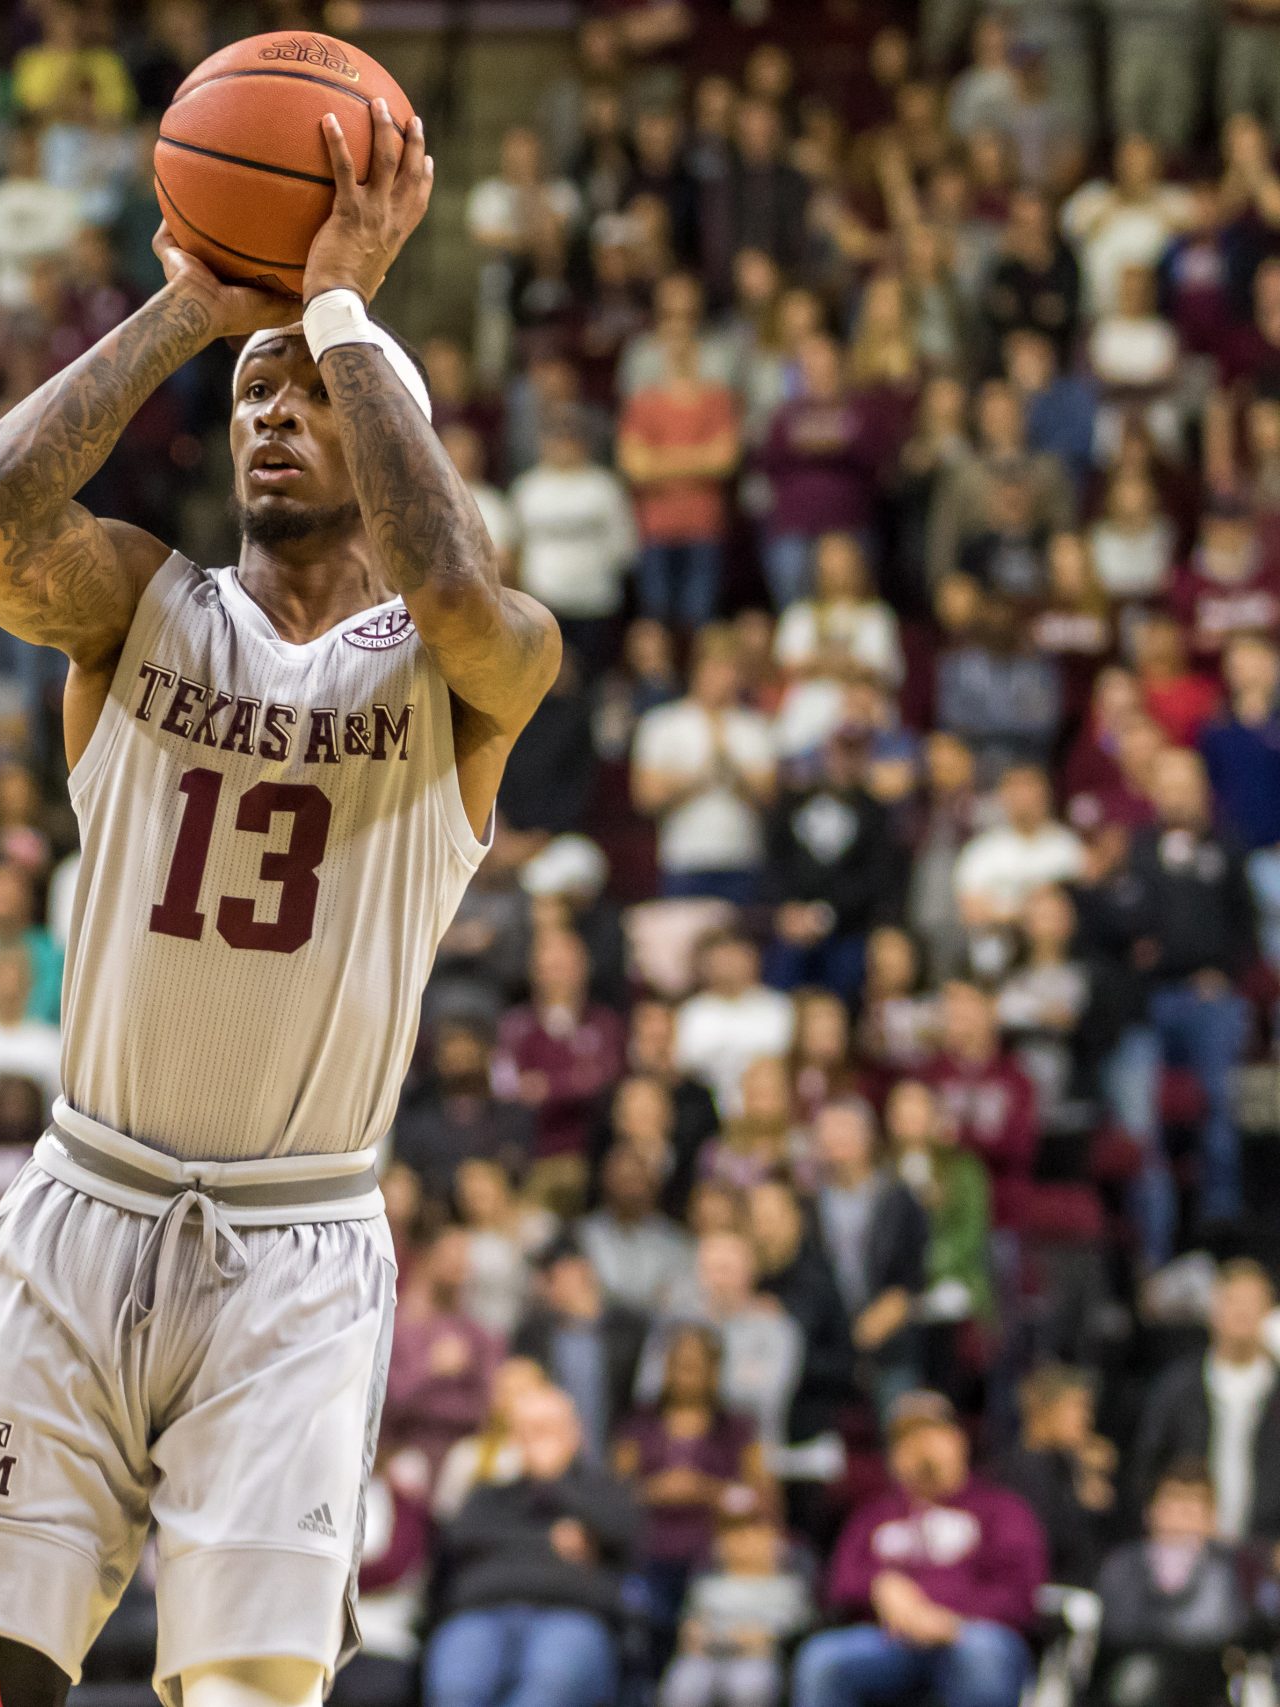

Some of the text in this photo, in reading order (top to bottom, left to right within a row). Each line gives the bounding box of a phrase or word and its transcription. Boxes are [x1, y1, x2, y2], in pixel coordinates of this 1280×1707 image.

[259, 40, 360, 82] adidas
[352, 625, 412, 648] GRADUATE
[135, 660, 415, 764] TEXAS A&M
[149, 766, 333, 954] 13
